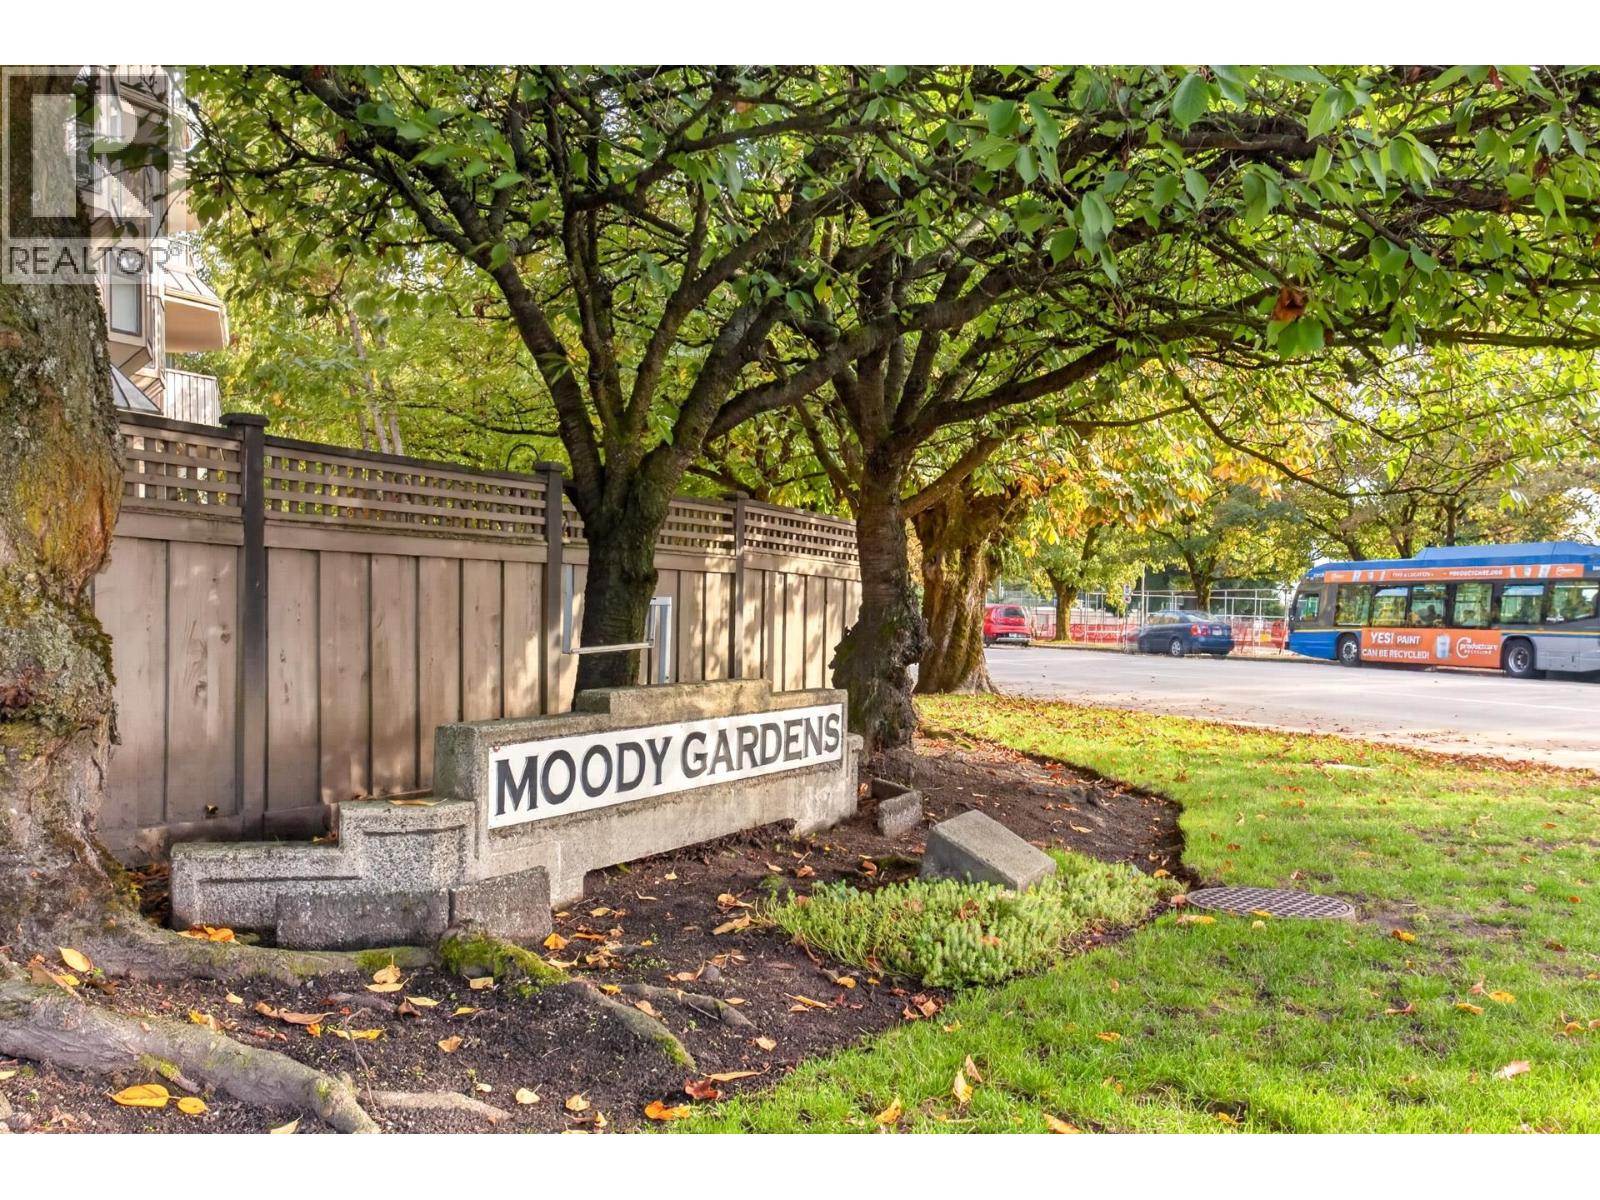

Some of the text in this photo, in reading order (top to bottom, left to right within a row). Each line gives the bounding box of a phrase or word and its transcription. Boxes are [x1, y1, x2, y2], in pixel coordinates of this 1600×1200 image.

[1370, 632, 1421, 645] YES! PAINT
[1362, 648, 1430, 660] CAN BE RECYCLED!
[494, 713, 841, 816] MOODY GARDENS
